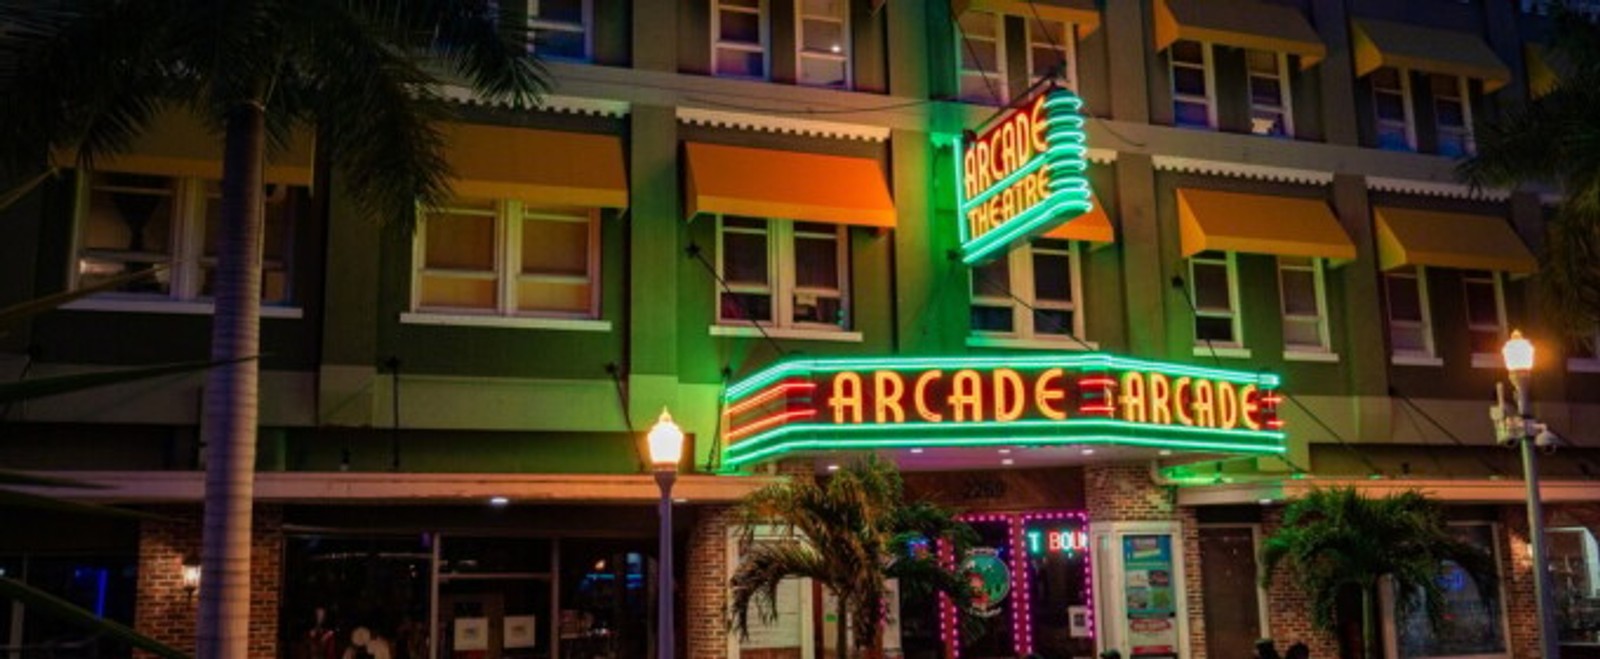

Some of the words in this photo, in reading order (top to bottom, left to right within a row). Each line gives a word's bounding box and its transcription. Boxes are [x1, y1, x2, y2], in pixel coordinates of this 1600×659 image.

[964, 95, 1048, 200] ARCADE
[967, 164, 1050, 241] THEATRE
[828, 368, 1066, 424] ARCADE
[1118, 371, 1260, 431] ARCADE
